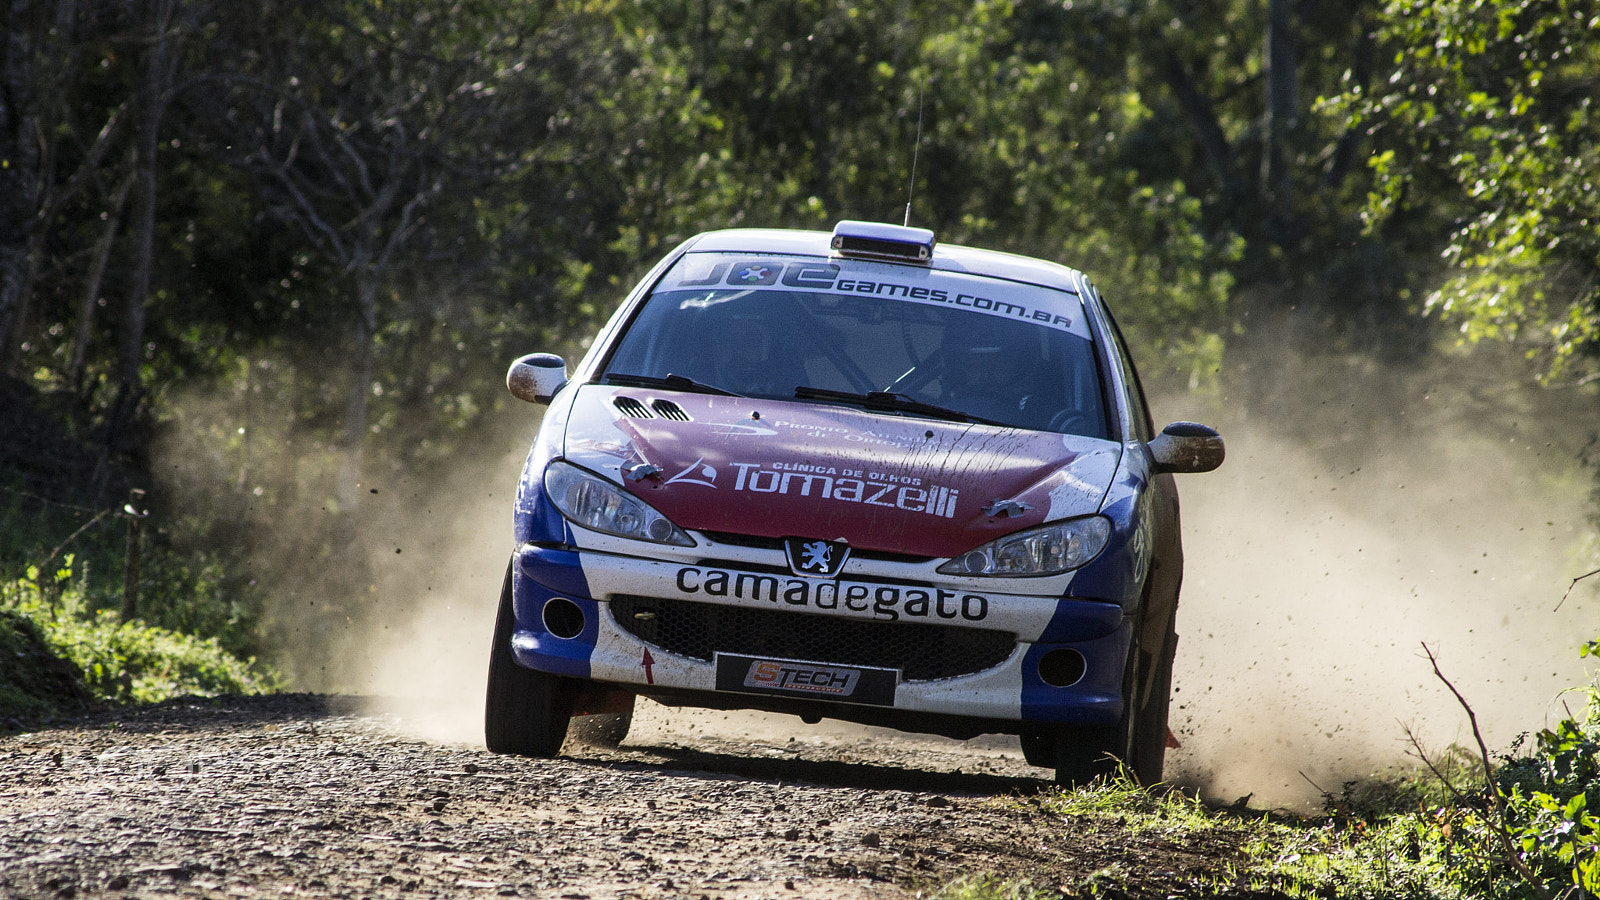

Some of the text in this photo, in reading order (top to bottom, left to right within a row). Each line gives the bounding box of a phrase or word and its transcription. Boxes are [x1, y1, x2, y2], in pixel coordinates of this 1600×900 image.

[729, 461, 959, 519] Tomazelli
[842, 468, 864, 479] DE
[869, 471, 923, 487] OLHOS
[676, 566, 989, 622] camadegato
[753, 663, 850, 688] STECH
